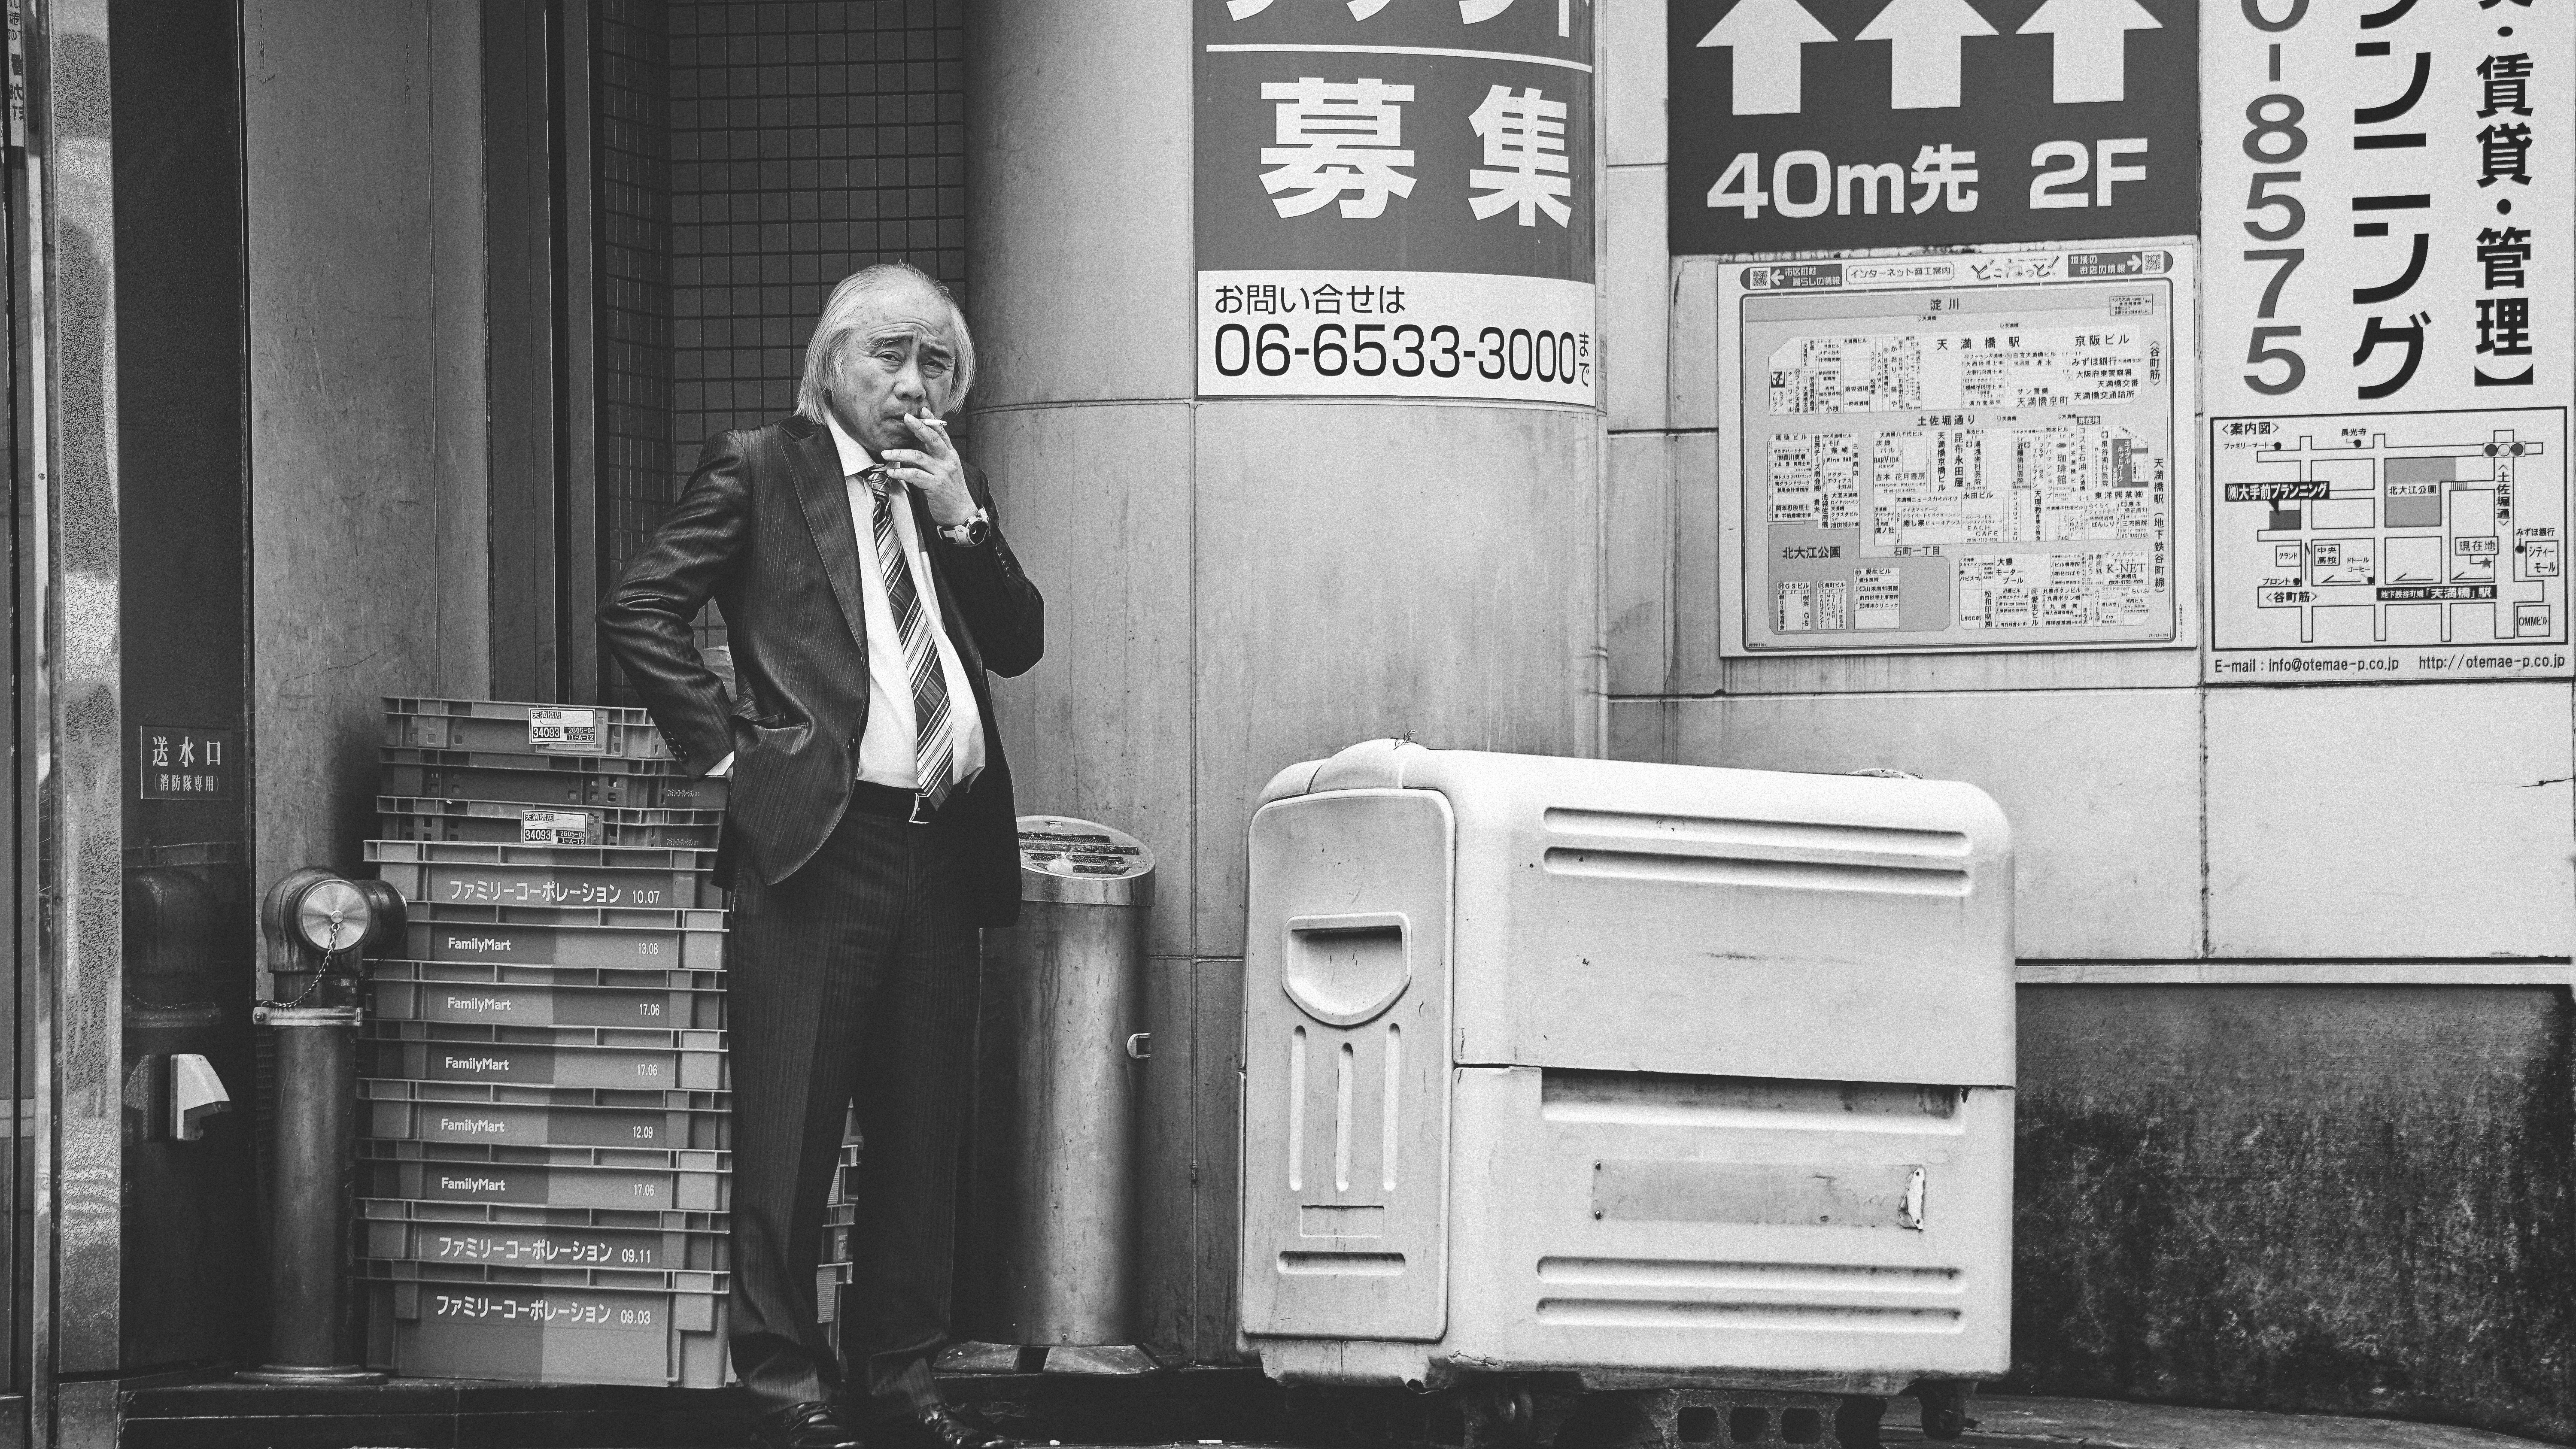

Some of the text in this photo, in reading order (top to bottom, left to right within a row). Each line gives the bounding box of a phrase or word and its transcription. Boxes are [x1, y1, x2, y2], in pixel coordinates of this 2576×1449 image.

[1258, 77, 1572, 228] 募集
[1707, 138, 2148, 218] 40m先 2F
[2475, 0, 2533, 386] ・賃貸・管理】
[1785, 267, 1817, 276] 市区町村
[1850, 267, 1951, 278] インターネット商工案内
[1793, 277, 1841, 286] 暮らしの情報
[1215, 284, 1405, 315] お問い合せは
[1930, 298, 1959, 310] 淀川
[1937, 336, 2020, 350] 天満橋駅
[2075, 334, 2129, 346] 京阪ビル
[1215, 323, 1575, 384] 06-6533-3000
[1579, 331, 1589, 387] まで
[2072, 357, 2117, 366] みずほ銀行
[2076, 369, 2131, 378] 大阪府東警察署
[2098, 379, 2139, 388] 天満橋交番
[2017, 396, 2069, 407] 天満橋京町
[2074, 391, 2135, 400] 天満橋交通詰所
[1917, 414, 1975, 426] 土佐堀通り
[1954, 433, 1963, 488] 昆布永田屋
[2057, 454, 2066, 485] 珈琲館
[1962, 491, 1993, 499] 永田ビル
[2388, 484, 2436, 496] 北大江公園
[2515, 527, 2555, 537] みずほ銀行
[1893, 546, 1940, 556] 石町一丁目
[2316, 546, 2336, 555] 中央
[2459, 540, 2495, 552] 現在地
[2528, 546, 2555, 558] シティー
[1782, 546, 1841, 559] 北大江公園
[2317, 555, 2336, 564] 高校
[2106, 563, 2146, 574] K-NET
[2348, 565, 2371, 573] コーヒー
[2534, 562, 2555, 573] モール
[2518, 615, 2548, 627] OMMビル
[2419, 654, 2565, 671] http://otemae-p.co.jp
[533, 727, 560, 738] 34093
[152, 736, 222, 767] 送水口
[154, 773, 219, 793] (消防隊専用)
[525, 829, 551, 841] 34093
[450, 880, 660, 904] ファミリーコーポレーション 10.07
[448, 937, 659, 955] FamilyMart 13.08
[447, 997, 660, 1016] FamilyMart 17.06
[445, 1057, 658, 1077] FamilyMart 17.06
[441, 1119, 653, 1139] FamilyMart 12.09
[441, 1177, 654, 1197] FamilyMart 17.06
[439, 1237, 651, 1264] ファミリーコーポレーション 09.11
[436, 1295, 651, 1325] ファミリーコーポレーション 09.03
